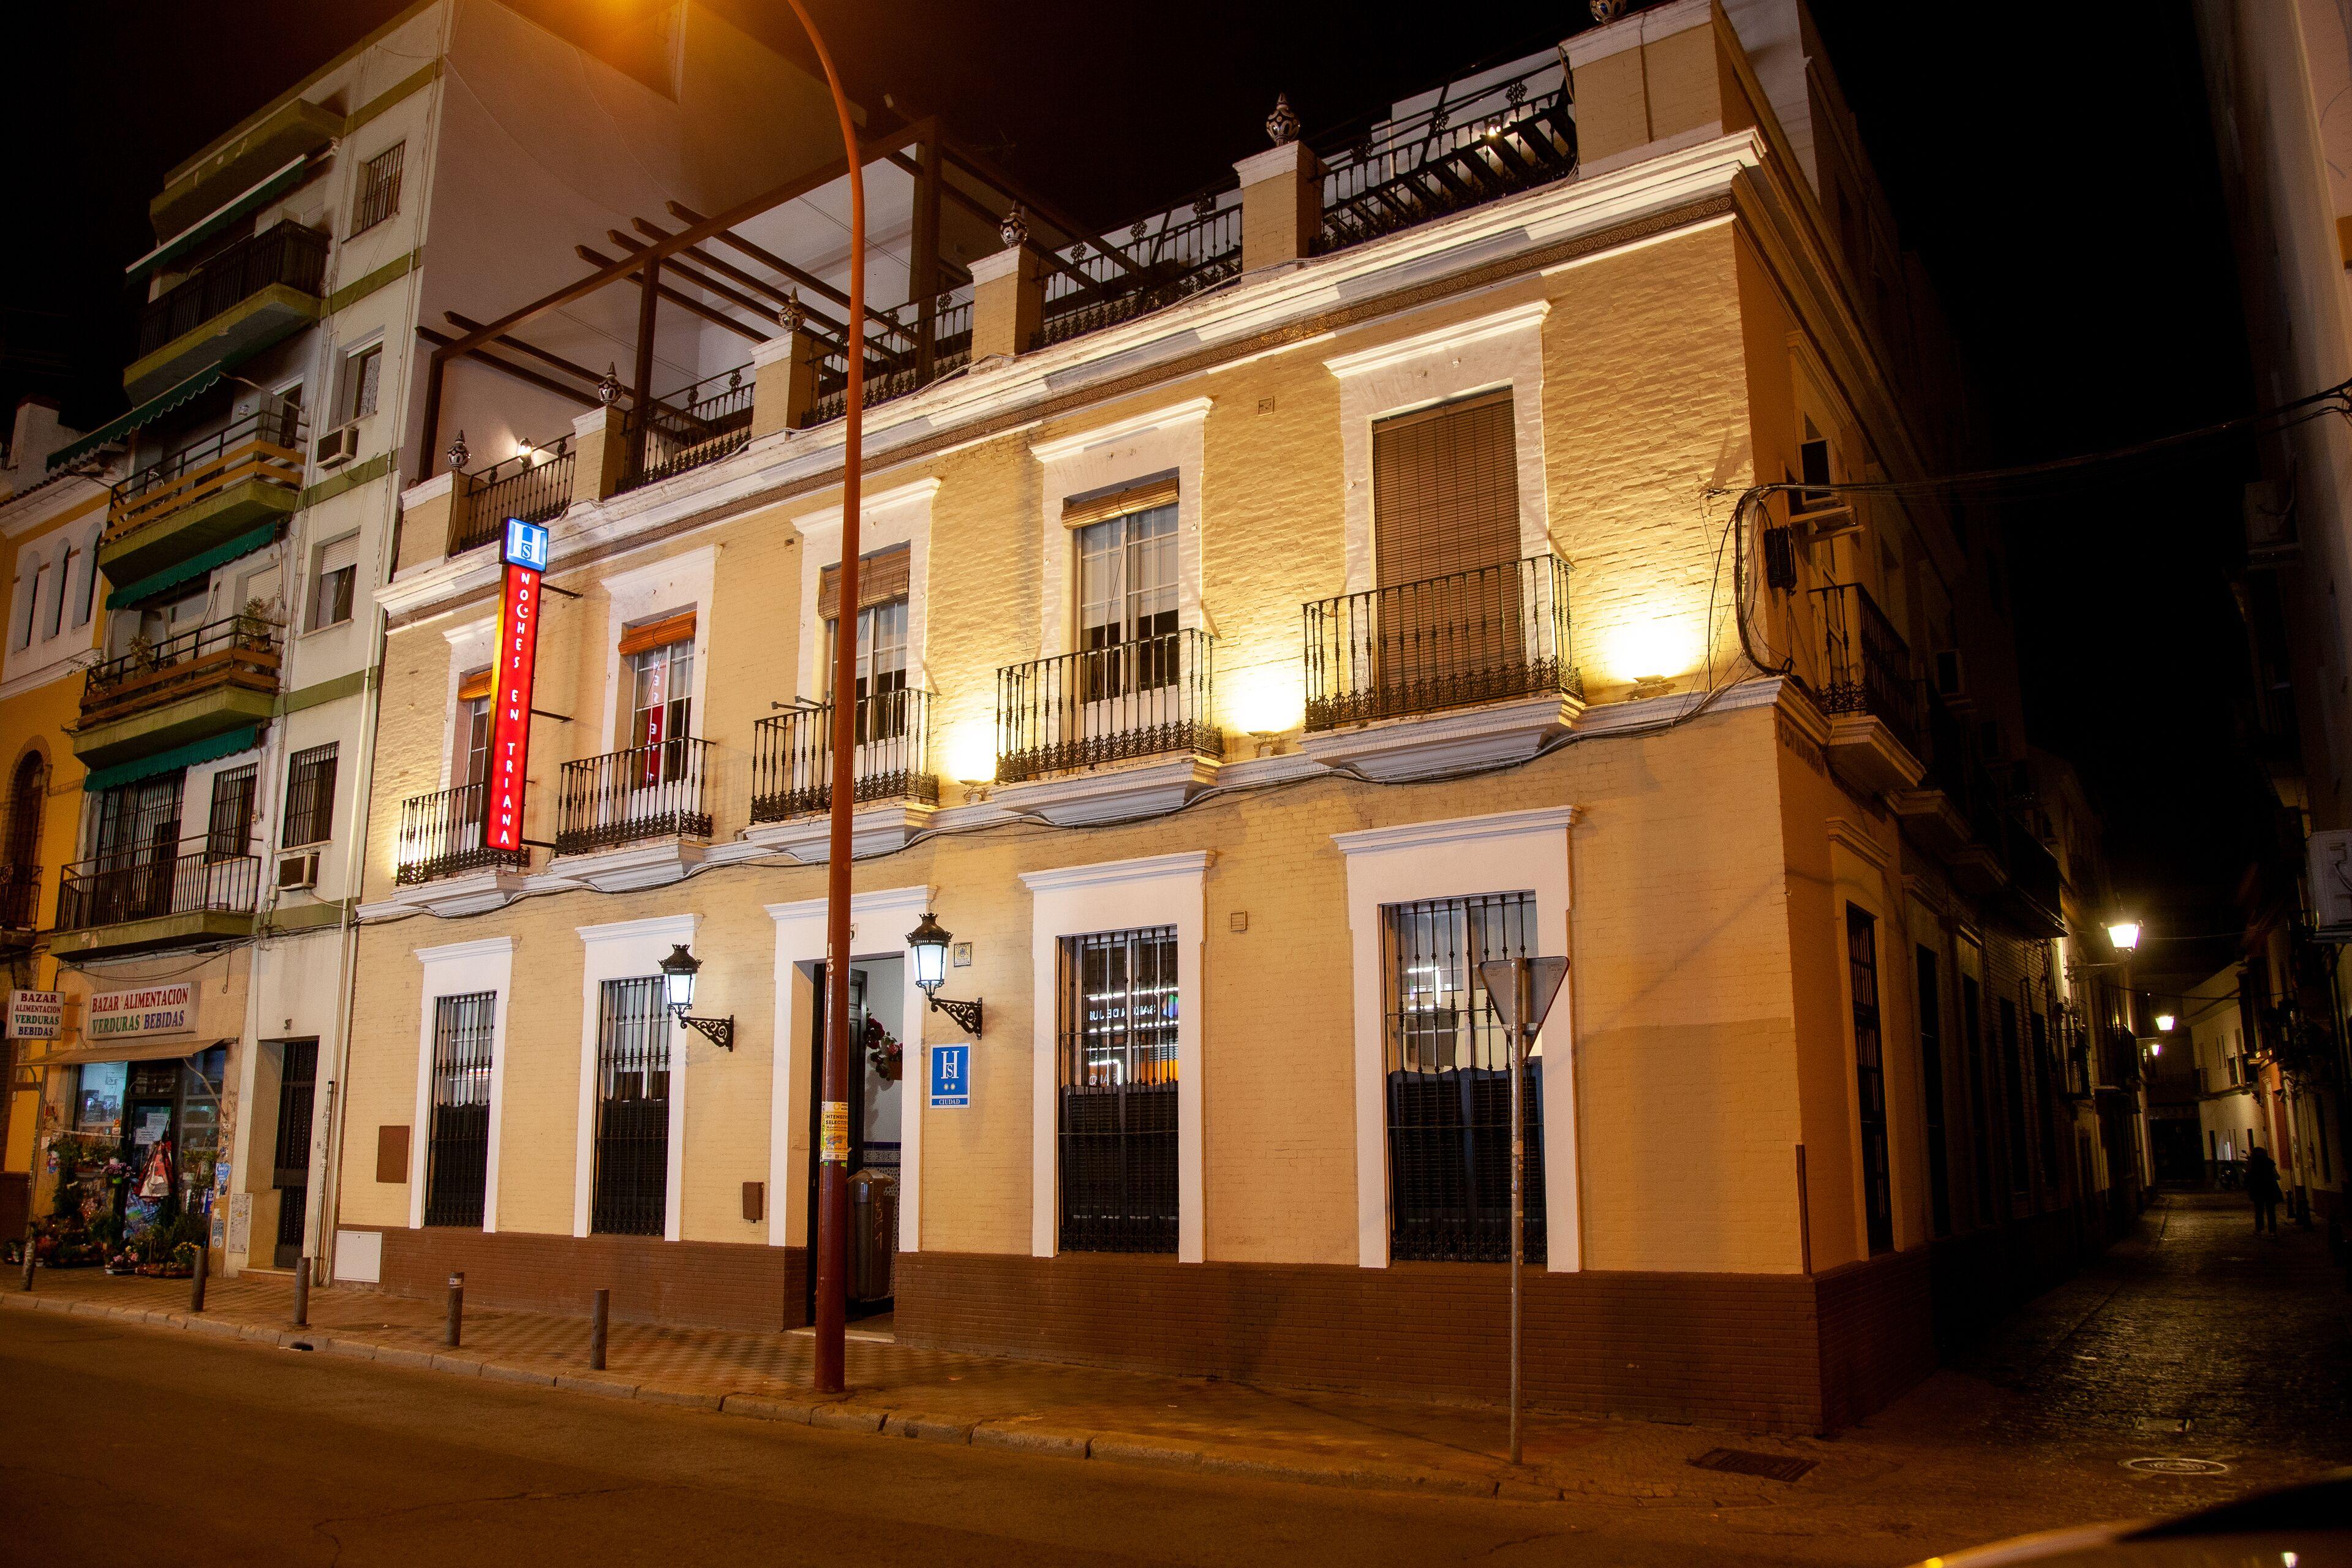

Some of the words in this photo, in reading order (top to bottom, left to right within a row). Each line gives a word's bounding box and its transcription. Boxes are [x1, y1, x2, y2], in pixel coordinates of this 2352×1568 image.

[510, 690, 519, 721] EN
[500, 742, 516, 845] TRIANA
[20, 993, 58, 1003] BAZAR
[92, 995, 119, 1013] BAZAR
[123, 987, 189, 1009] ALIMENTACION
[15, 1005, 61, 1013] ALIMENTACION
[15, 1014, 59, 1025] VERDURAS
[92, 1014, 140, 1035] VERDURAS
[143, 1010, 185, 1030] BEBIDAS
[18, 1027, 54, 1036] BEBIDAS
